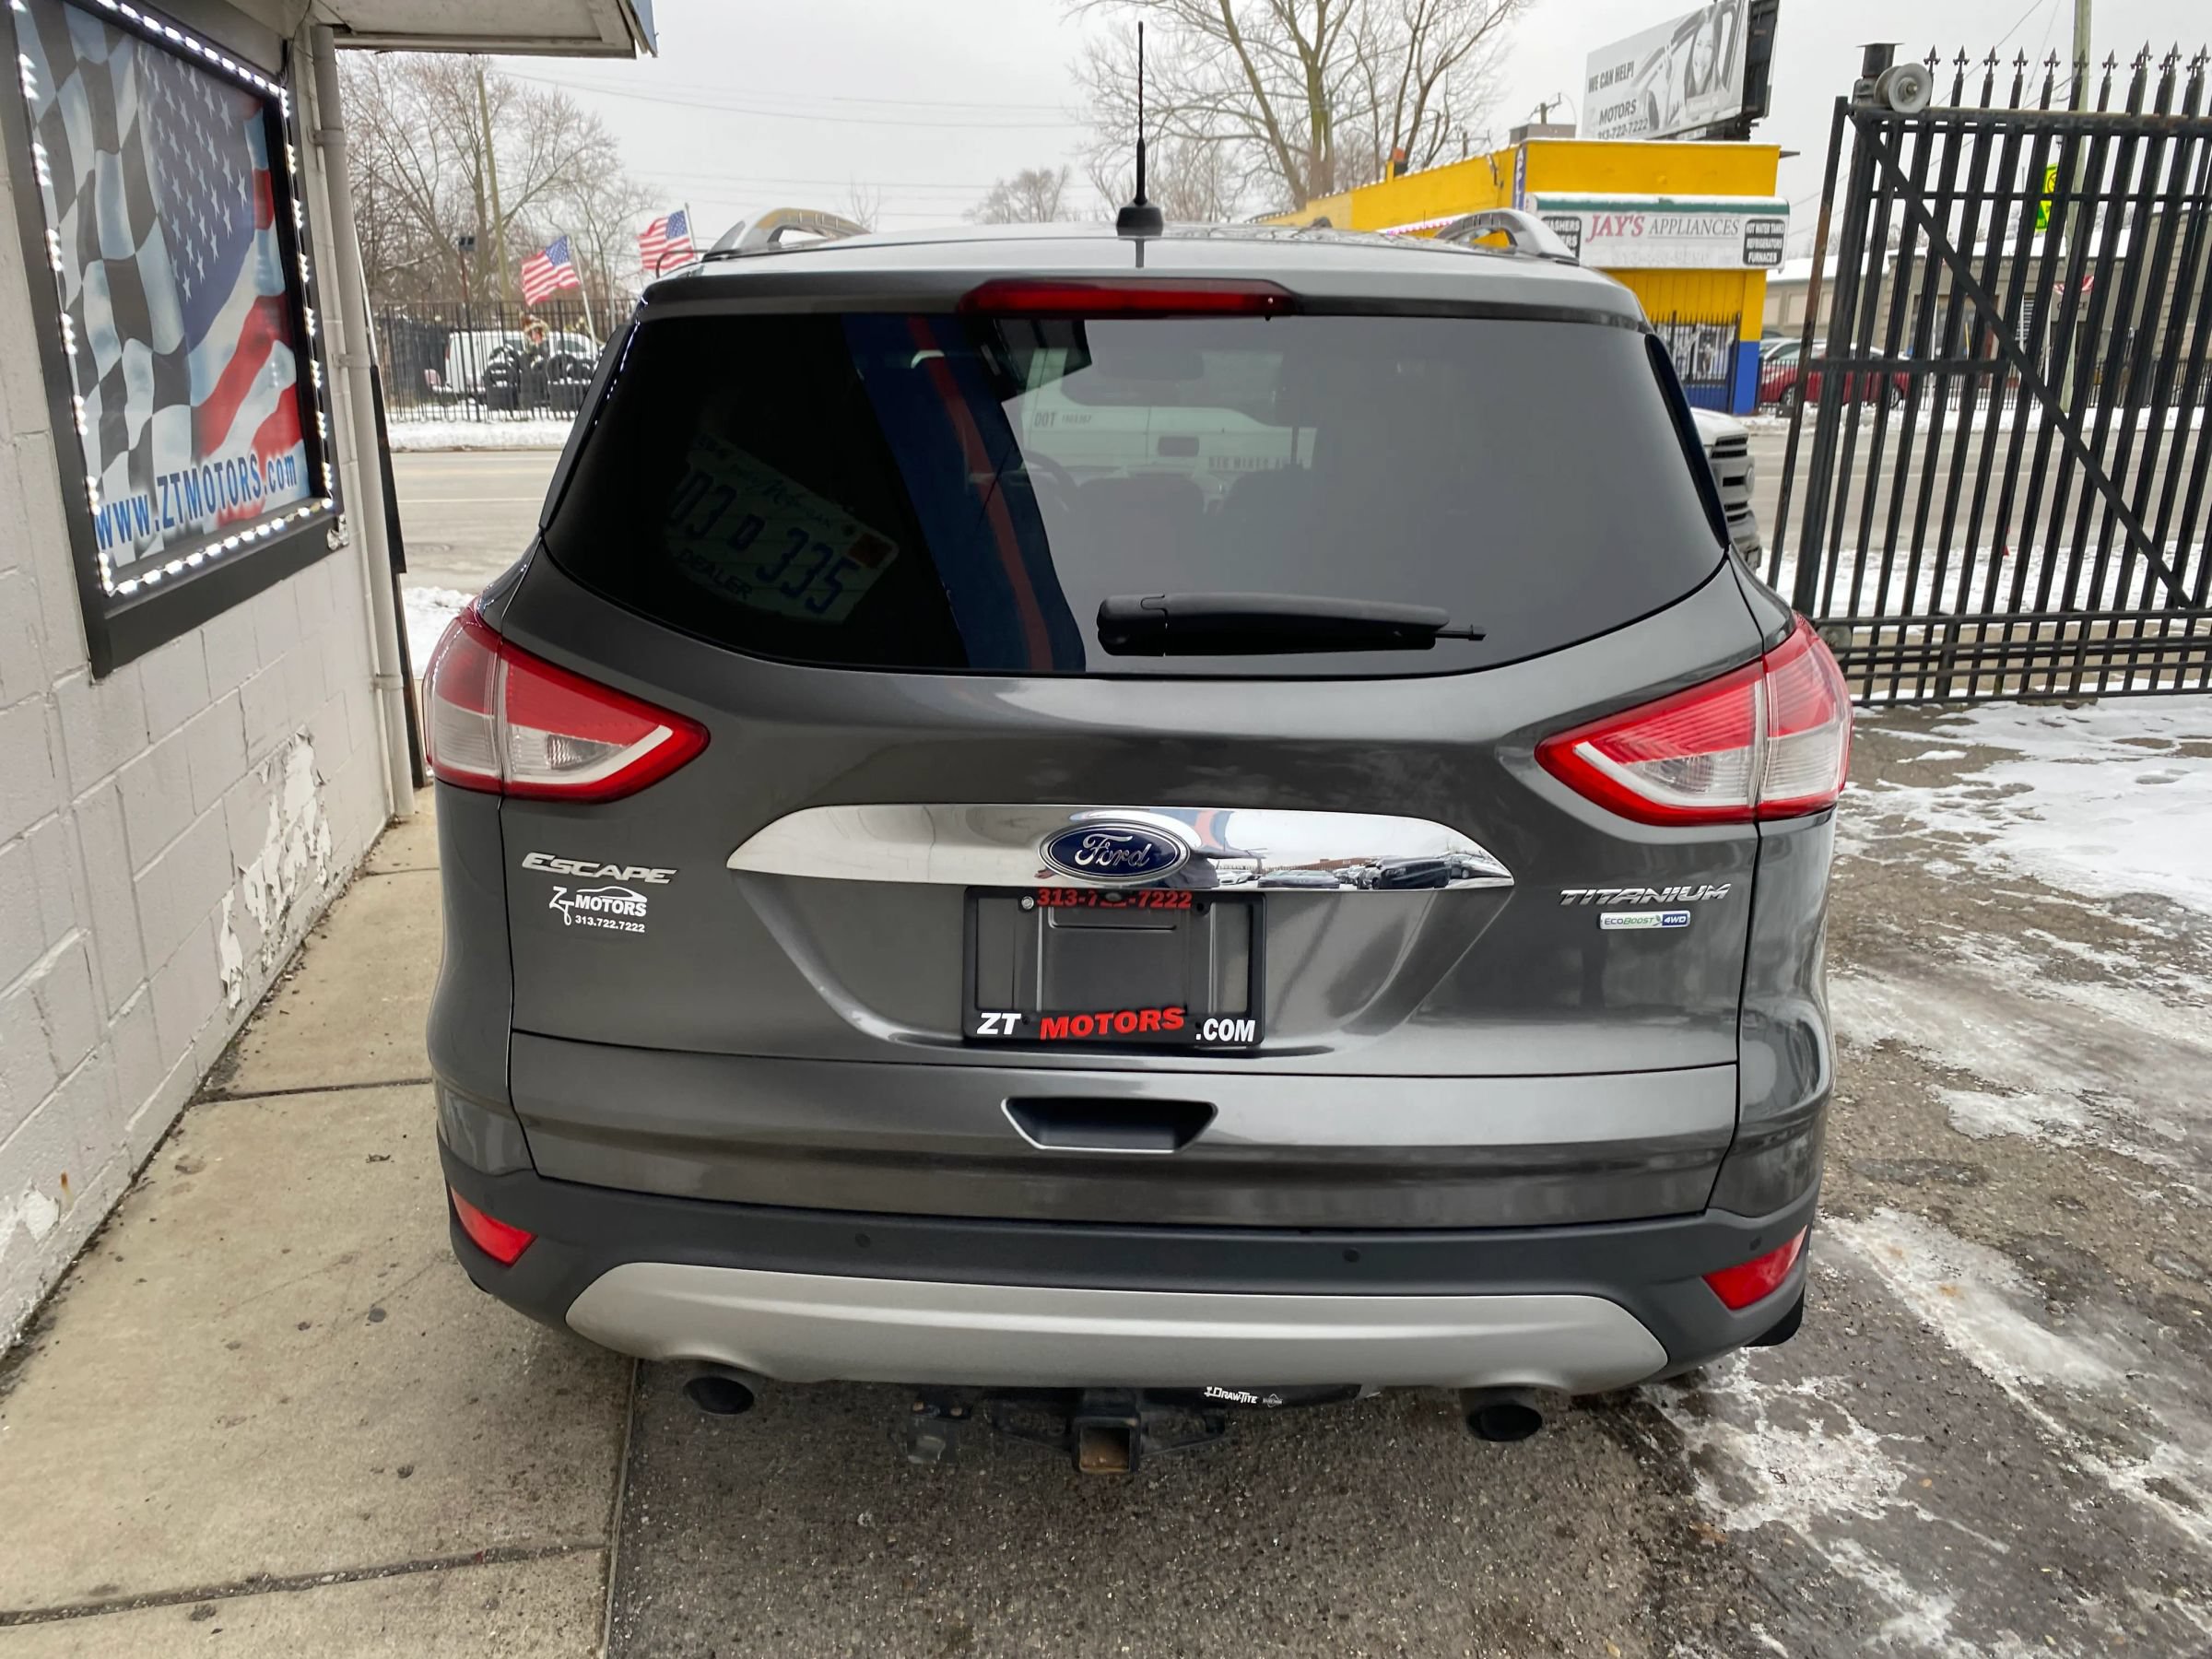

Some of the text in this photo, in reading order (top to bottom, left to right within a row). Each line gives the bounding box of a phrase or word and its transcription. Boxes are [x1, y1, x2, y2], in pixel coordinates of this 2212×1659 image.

[1588, 74, 1599, 93] WE
[1600, 67, 1614, 88] CAN
[1598, 99, 1637, 125] MOTORS
[1585, 214, 1740, 242] JAY'S APPLIANCES
[677, 548, 753, 600] DEALER
[1075, 833, 1153, 867] Ford
[522, 852, 677, 884] ESCAPE
[575, 895, 647, 917] MOTORS
[1037, 888, 1193, 909] 313-7-7222
[1560, 883, 1732, 906] TITANIUM
[575, 915, 646, 933] 313.722.7222
[1663, 915, 1687, 924] 4WD
[976, 1006, 1256, 1042] ZT MOTORS .COM
